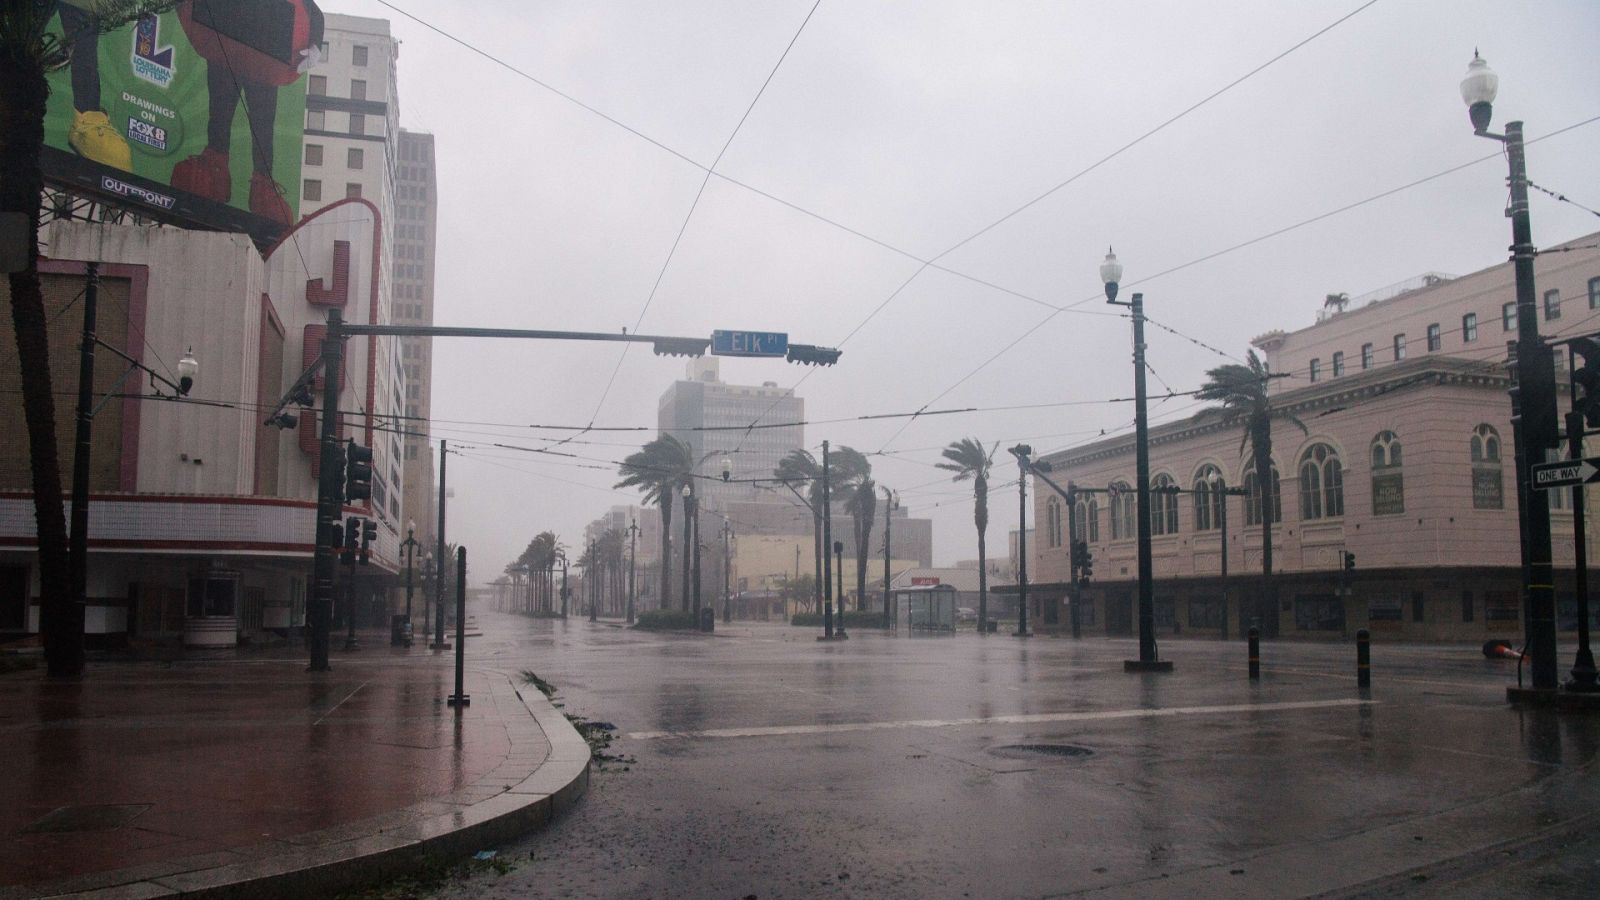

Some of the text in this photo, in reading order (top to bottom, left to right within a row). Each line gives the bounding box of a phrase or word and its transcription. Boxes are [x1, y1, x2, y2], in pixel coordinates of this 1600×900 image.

[133, 56, 171, 78] LOUISIANA
[136, 65, 168, 83] LOTTERY
[122, 92, 175, 118] DRAWINGS
[141, 111, 156, 123] ON
[129, 118, 165, 141] FOX 8
[105, 179, 171, 207] OUTFRONT
[732, 332, 761, 352] Elk
[1539, 467, 1580, 481] ONE WAY
